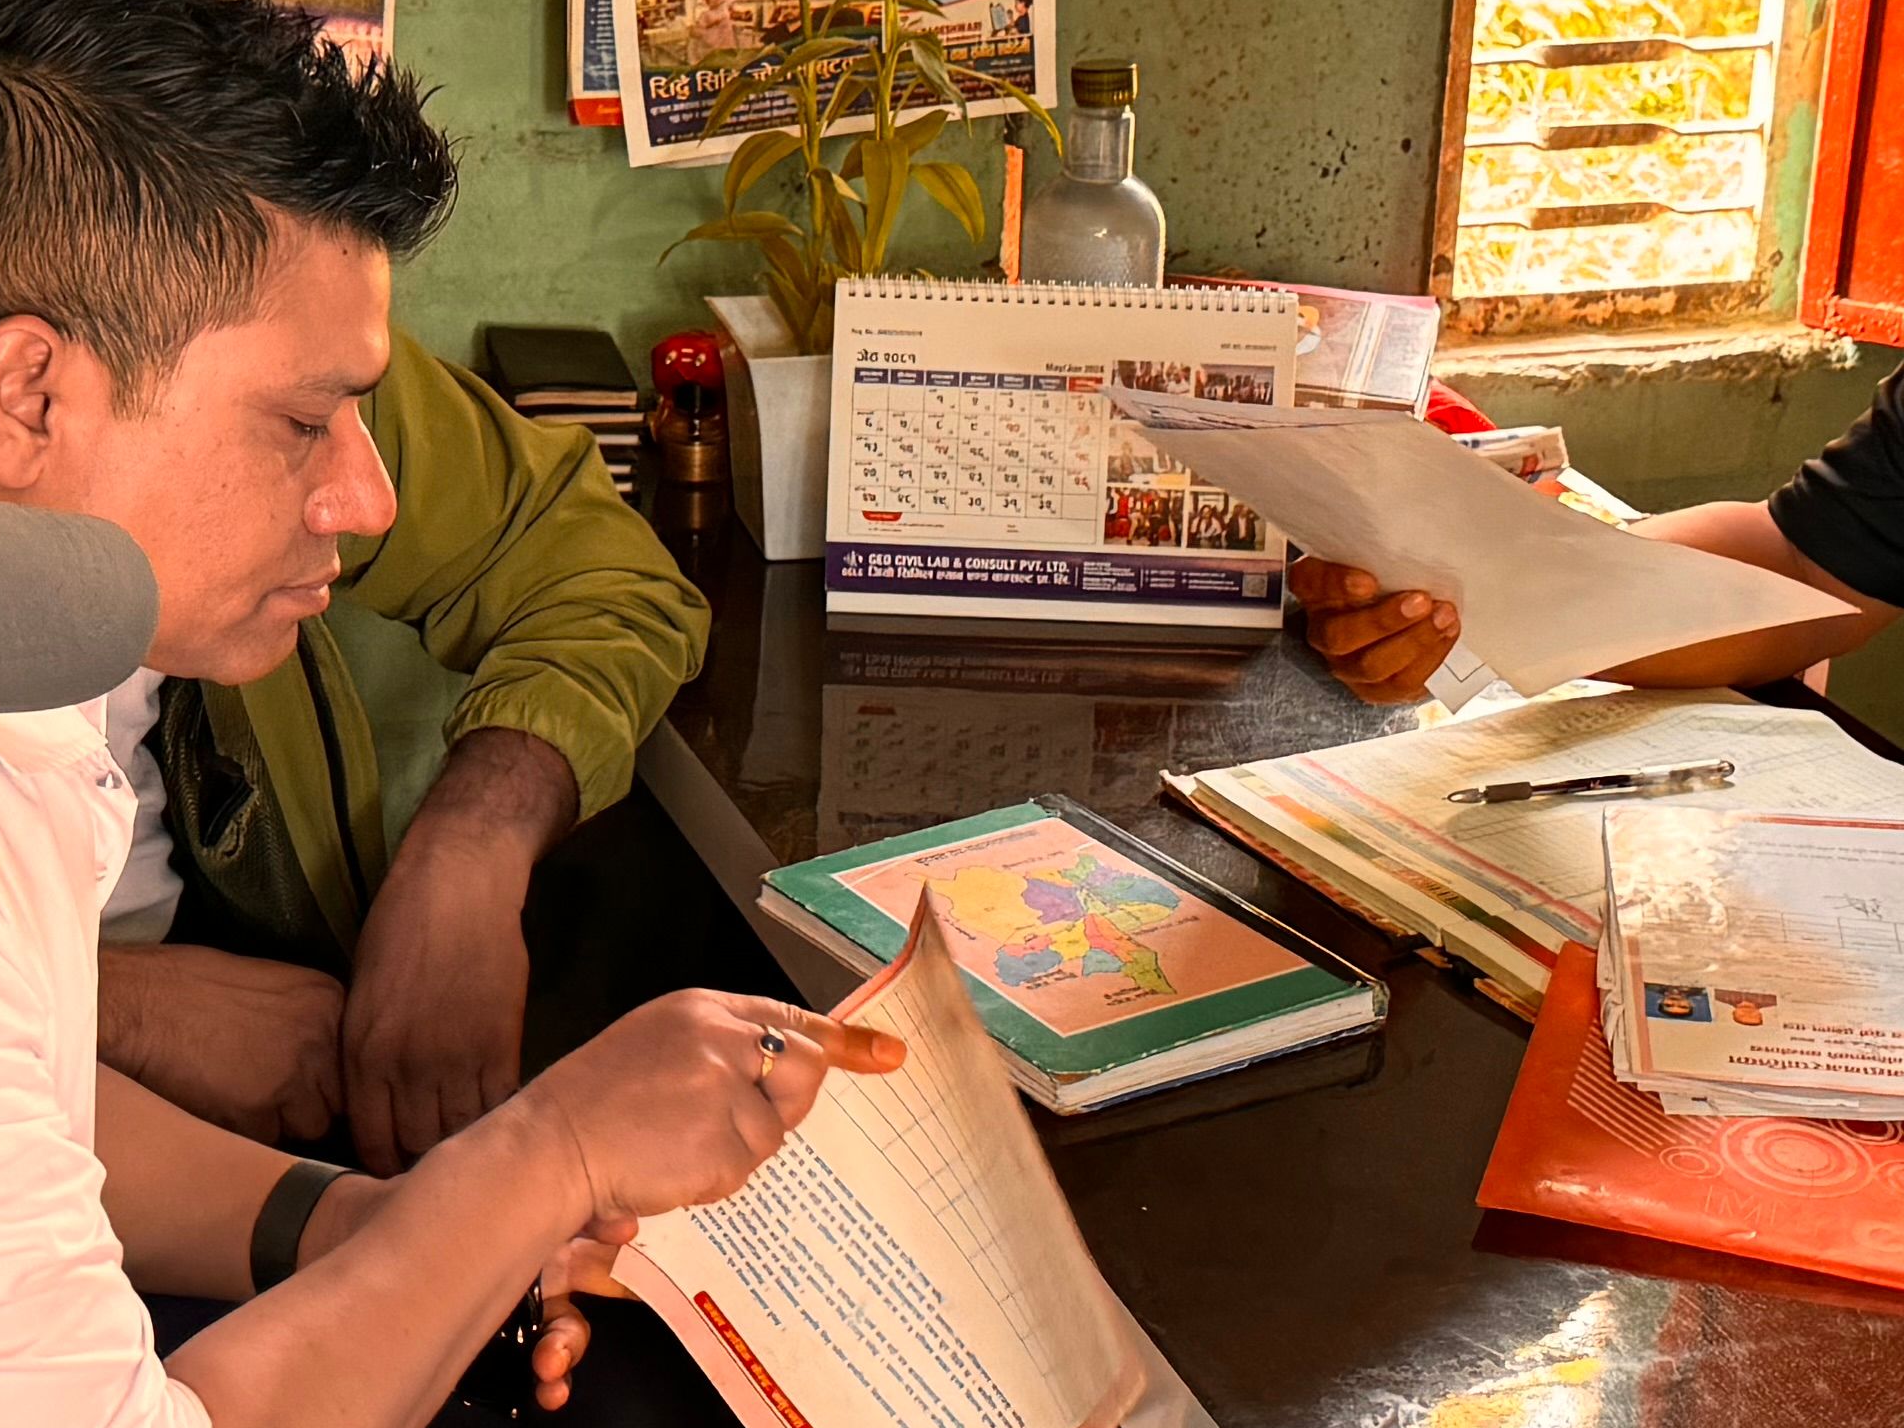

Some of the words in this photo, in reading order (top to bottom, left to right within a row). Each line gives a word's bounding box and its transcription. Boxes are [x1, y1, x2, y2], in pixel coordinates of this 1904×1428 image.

[856, 348, 878, 363] जेठ
[884, 352, 917, 364] २०८१
[868, 553, 891, 565] GEO
[895, 554, 924, 567] CIVIL
[928, 555, 949, 568] LAB
[953, 556, 962, 568] &
[965, 557, 1016, 570] CONSULT
[1019, 559, 1044, 572] PVT.
[1046, 560, 1070, 573] LTD.
